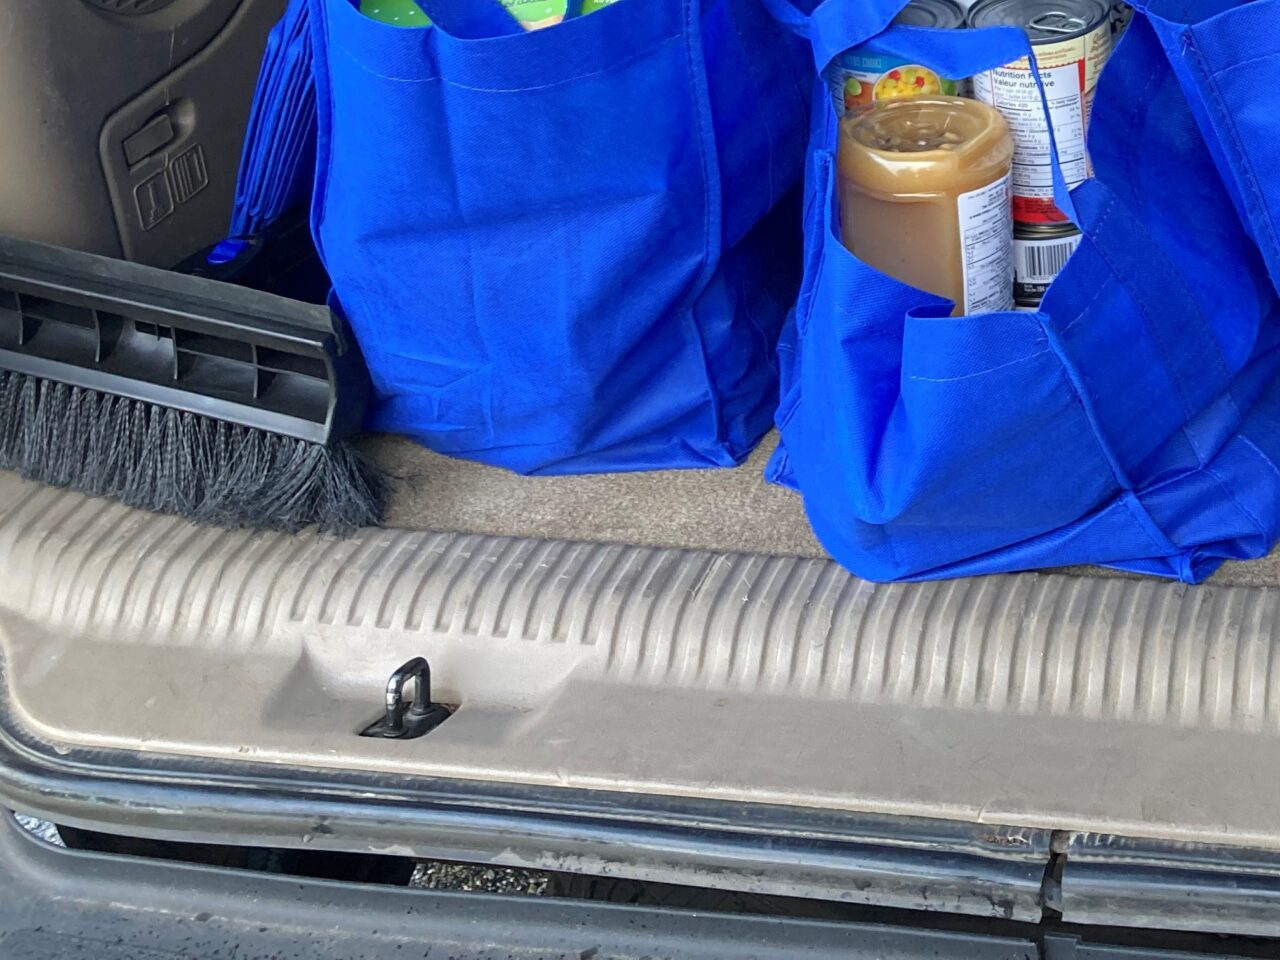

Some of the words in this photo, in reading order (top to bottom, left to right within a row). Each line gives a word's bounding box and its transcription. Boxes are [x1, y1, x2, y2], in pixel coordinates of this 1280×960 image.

[993, 69, 1025, 80] Nutrition
[1028, 71, 1052, 80] Fcts
[994, 77, 1018, 87] Valeur
[1019, 80, 1055, 88] nutrve
